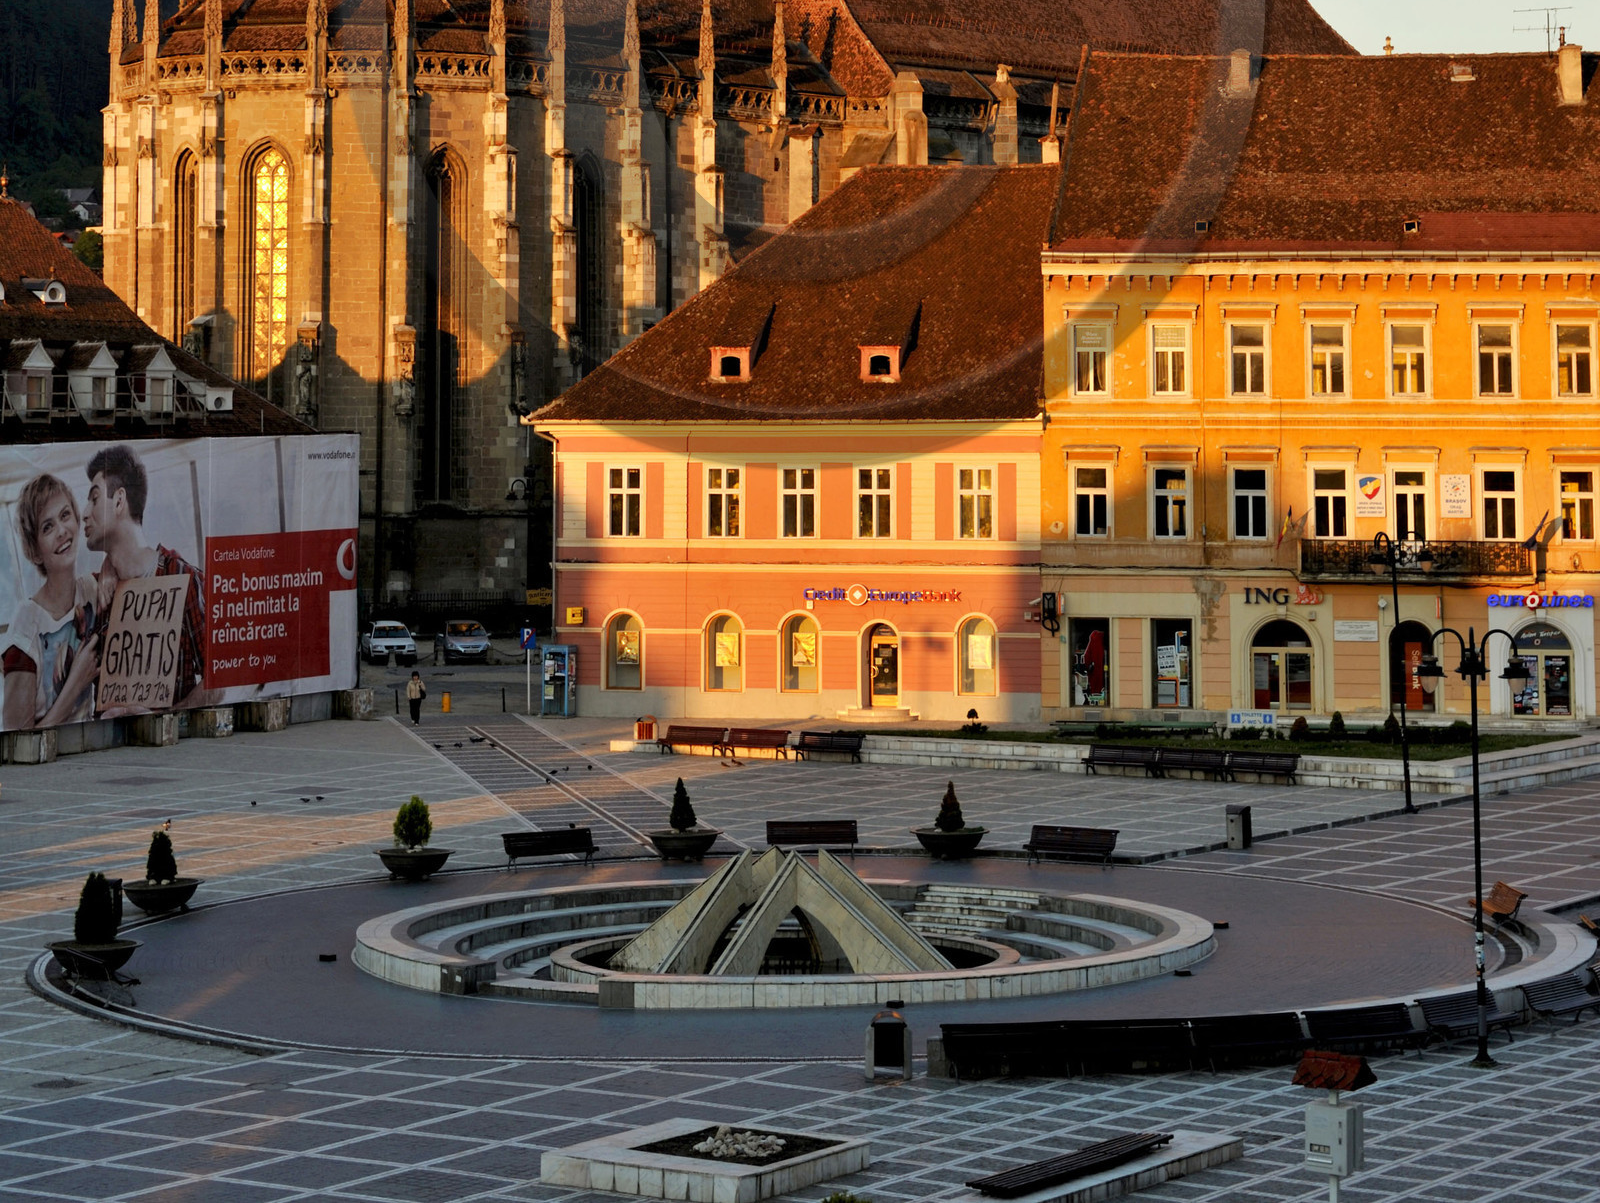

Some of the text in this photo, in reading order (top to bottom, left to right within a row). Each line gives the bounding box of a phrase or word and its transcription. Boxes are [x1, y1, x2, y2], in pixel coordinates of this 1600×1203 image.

[213, 547, 275, 562] Cartela Vodafone
[213, 568, 323, 595] Pac, bonus maxim
[120, 587, 182, 623] PUPAT
[803, 587, 846, 601] Credit
[1244, 587, 1290, 605] ING
[212, 593, 300, 624] și nelimitat la
[212, 621, 288, 644] reîncărcare.
[523, 628, 532, 645] P
[106, 629, 177, 677] GRATIS
[212, 653, 277, 674] power to you
[101, 682, 128, 705] 0722
[132, 682, 152, 703] 723
